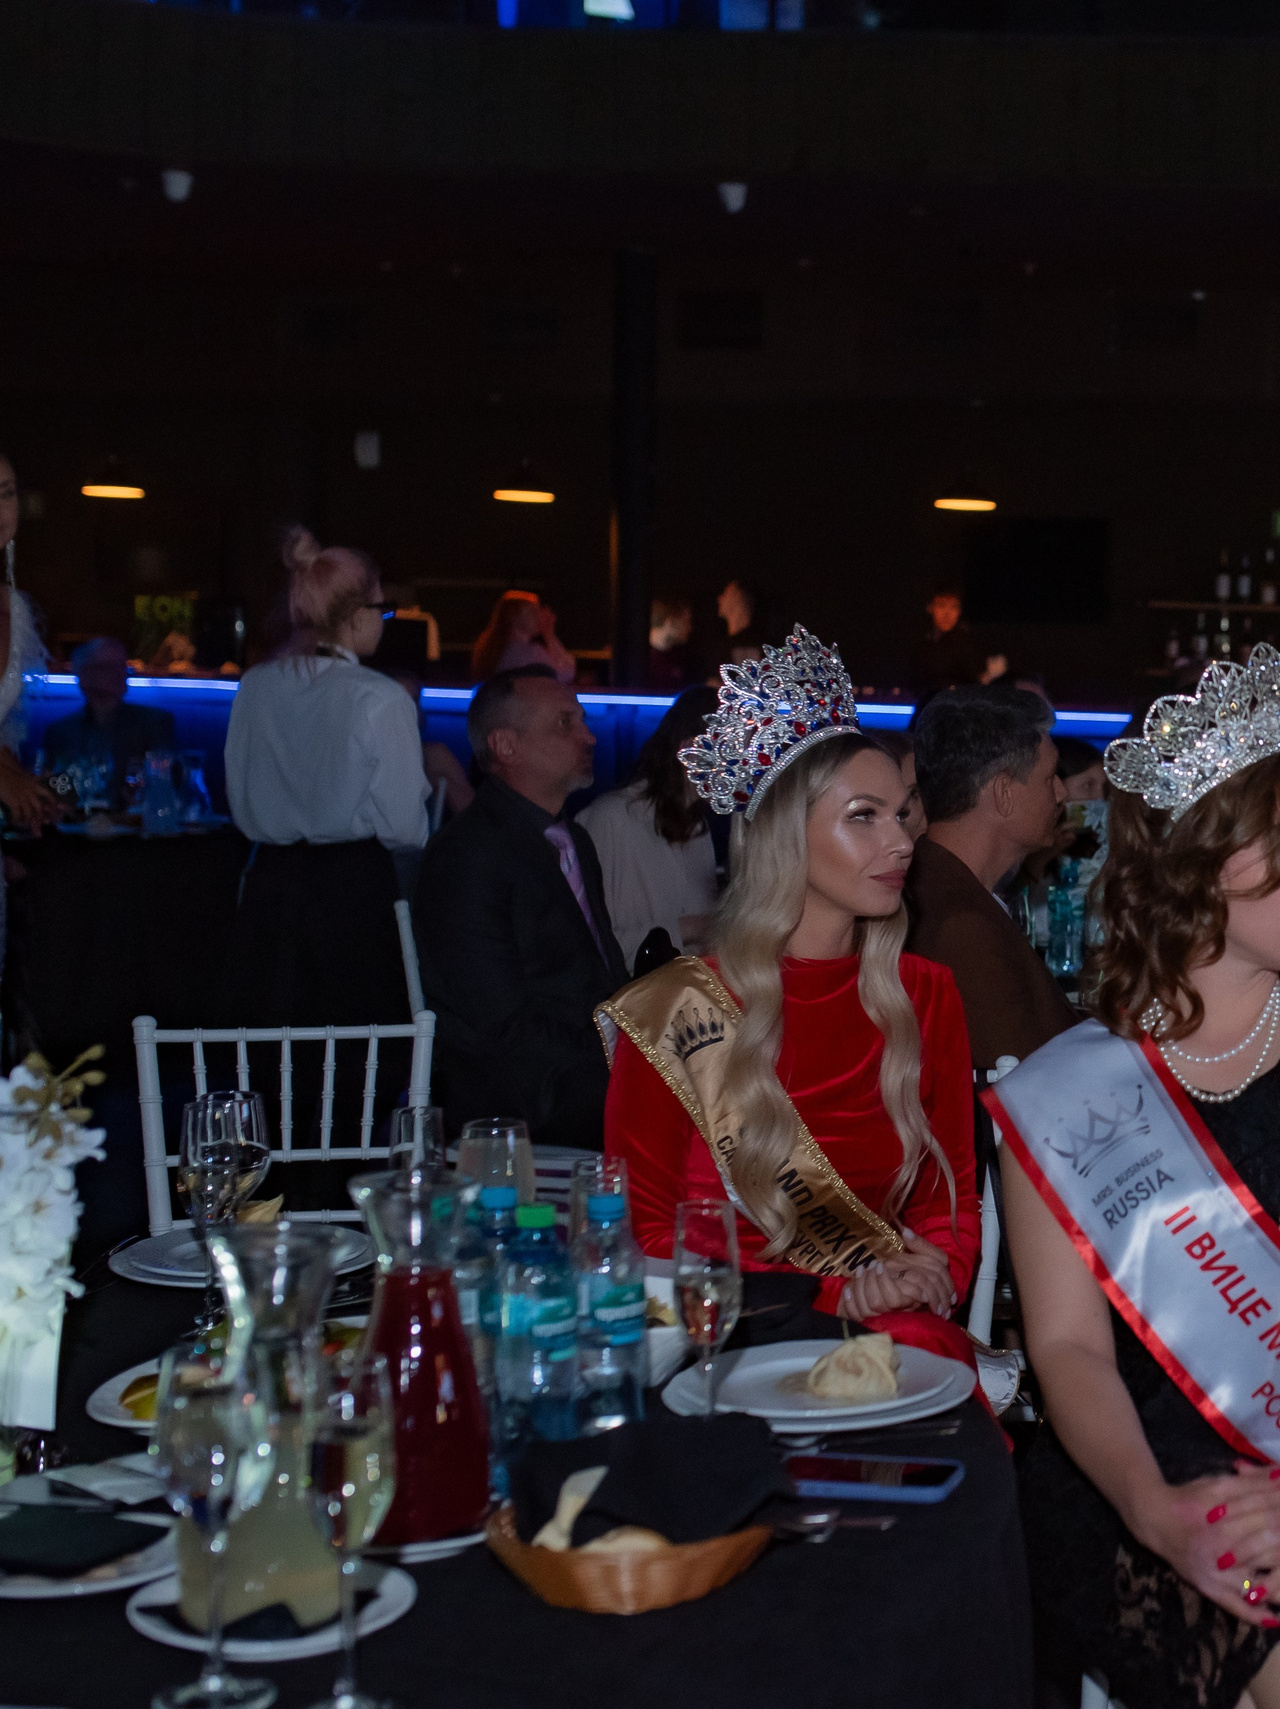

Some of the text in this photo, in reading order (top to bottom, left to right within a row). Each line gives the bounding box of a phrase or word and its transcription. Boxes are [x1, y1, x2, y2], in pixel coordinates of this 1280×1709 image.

[1102, 1168, 1175, 1229] RUSSIA
[791, 1232, 824, 1264] УРГ
[799, 1205, 856, 1254] PRIX
[1184, 1232, 1272, 1326] ВИЦЕ
